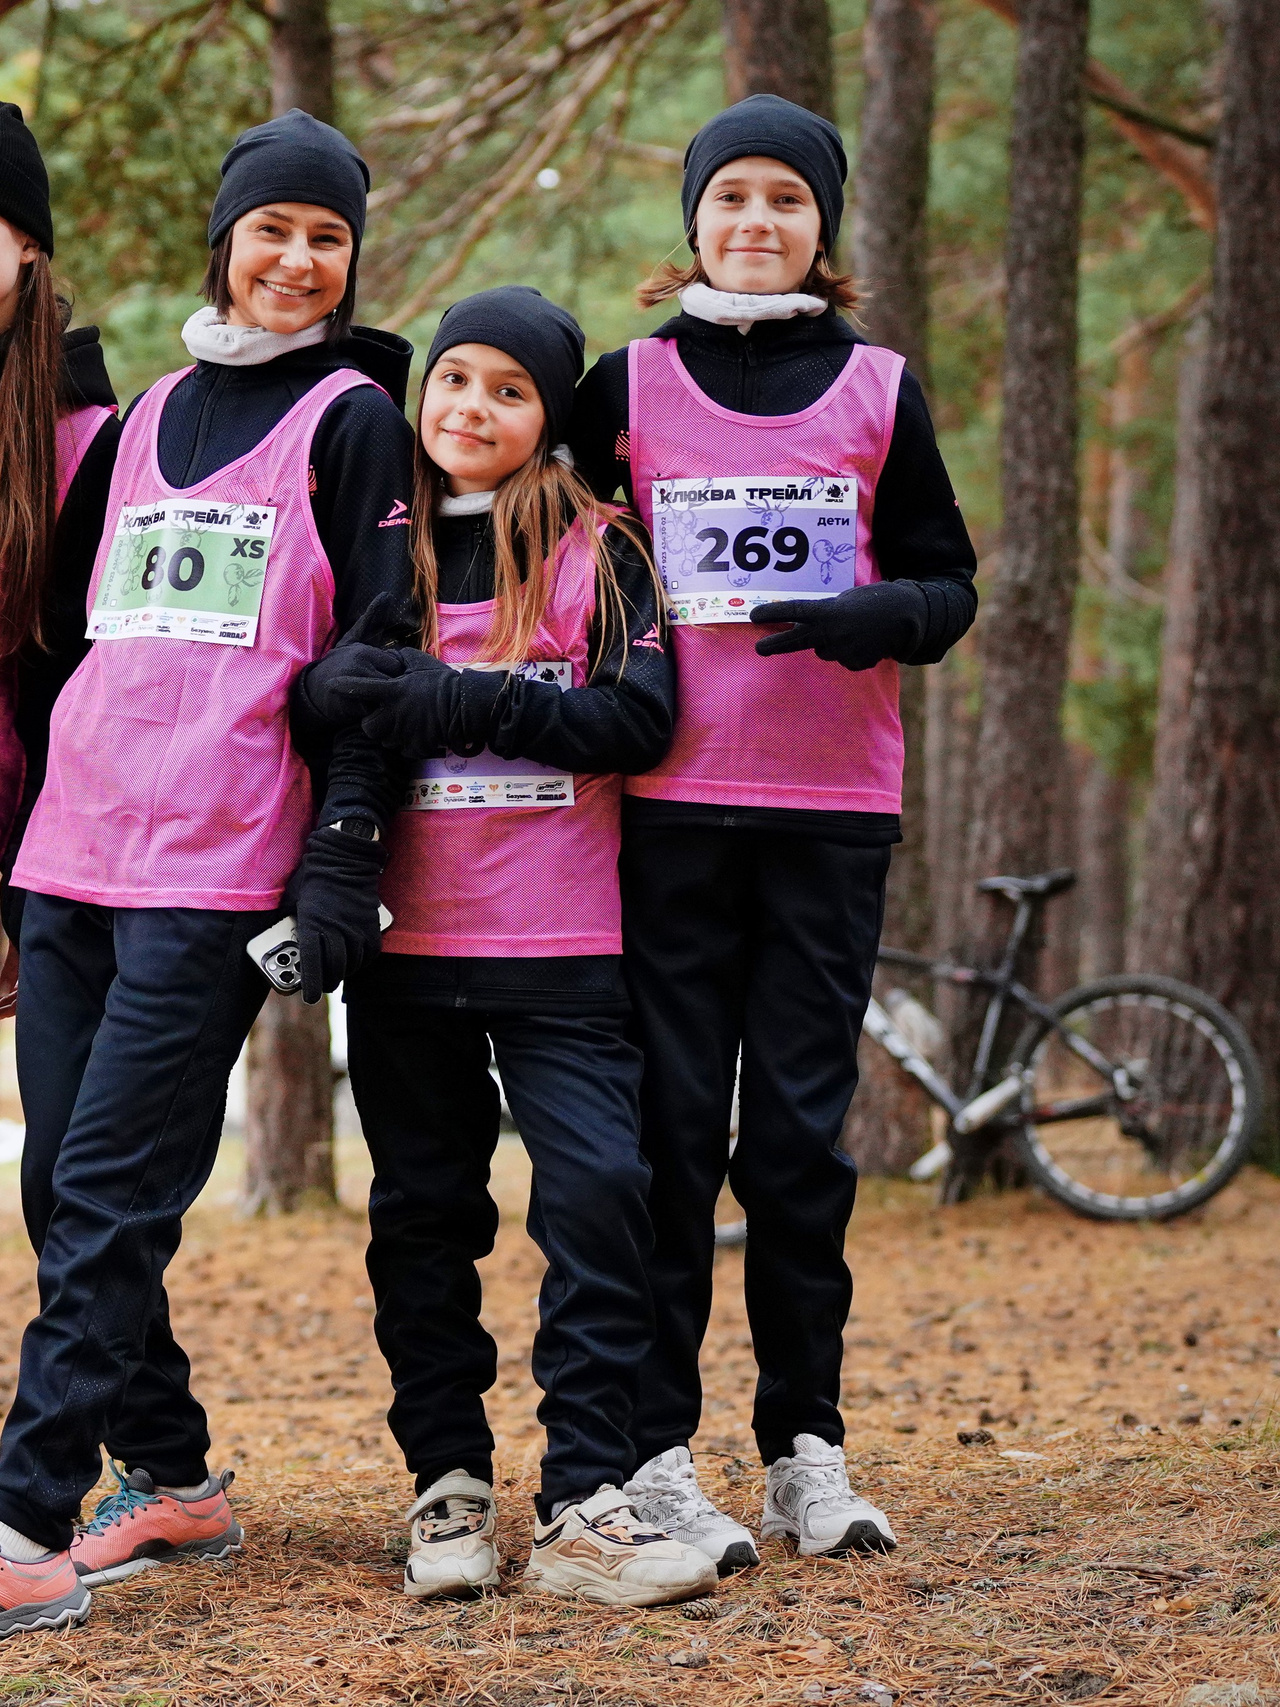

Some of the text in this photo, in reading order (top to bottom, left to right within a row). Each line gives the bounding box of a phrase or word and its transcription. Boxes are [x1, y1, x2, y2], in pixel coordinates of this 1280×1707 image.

[661, 484, 812, 504] КЛЮКВА ТРЕЙЛ
[124, 509, 232, 528] КЛЮКВА ТРЕЙЛ
[818, 517, 849, 527] дети
[696, 526, 809, 572] 269
[142, 538, 265, 591] 80 XS
[218, 631, 245, 639] JORDA
